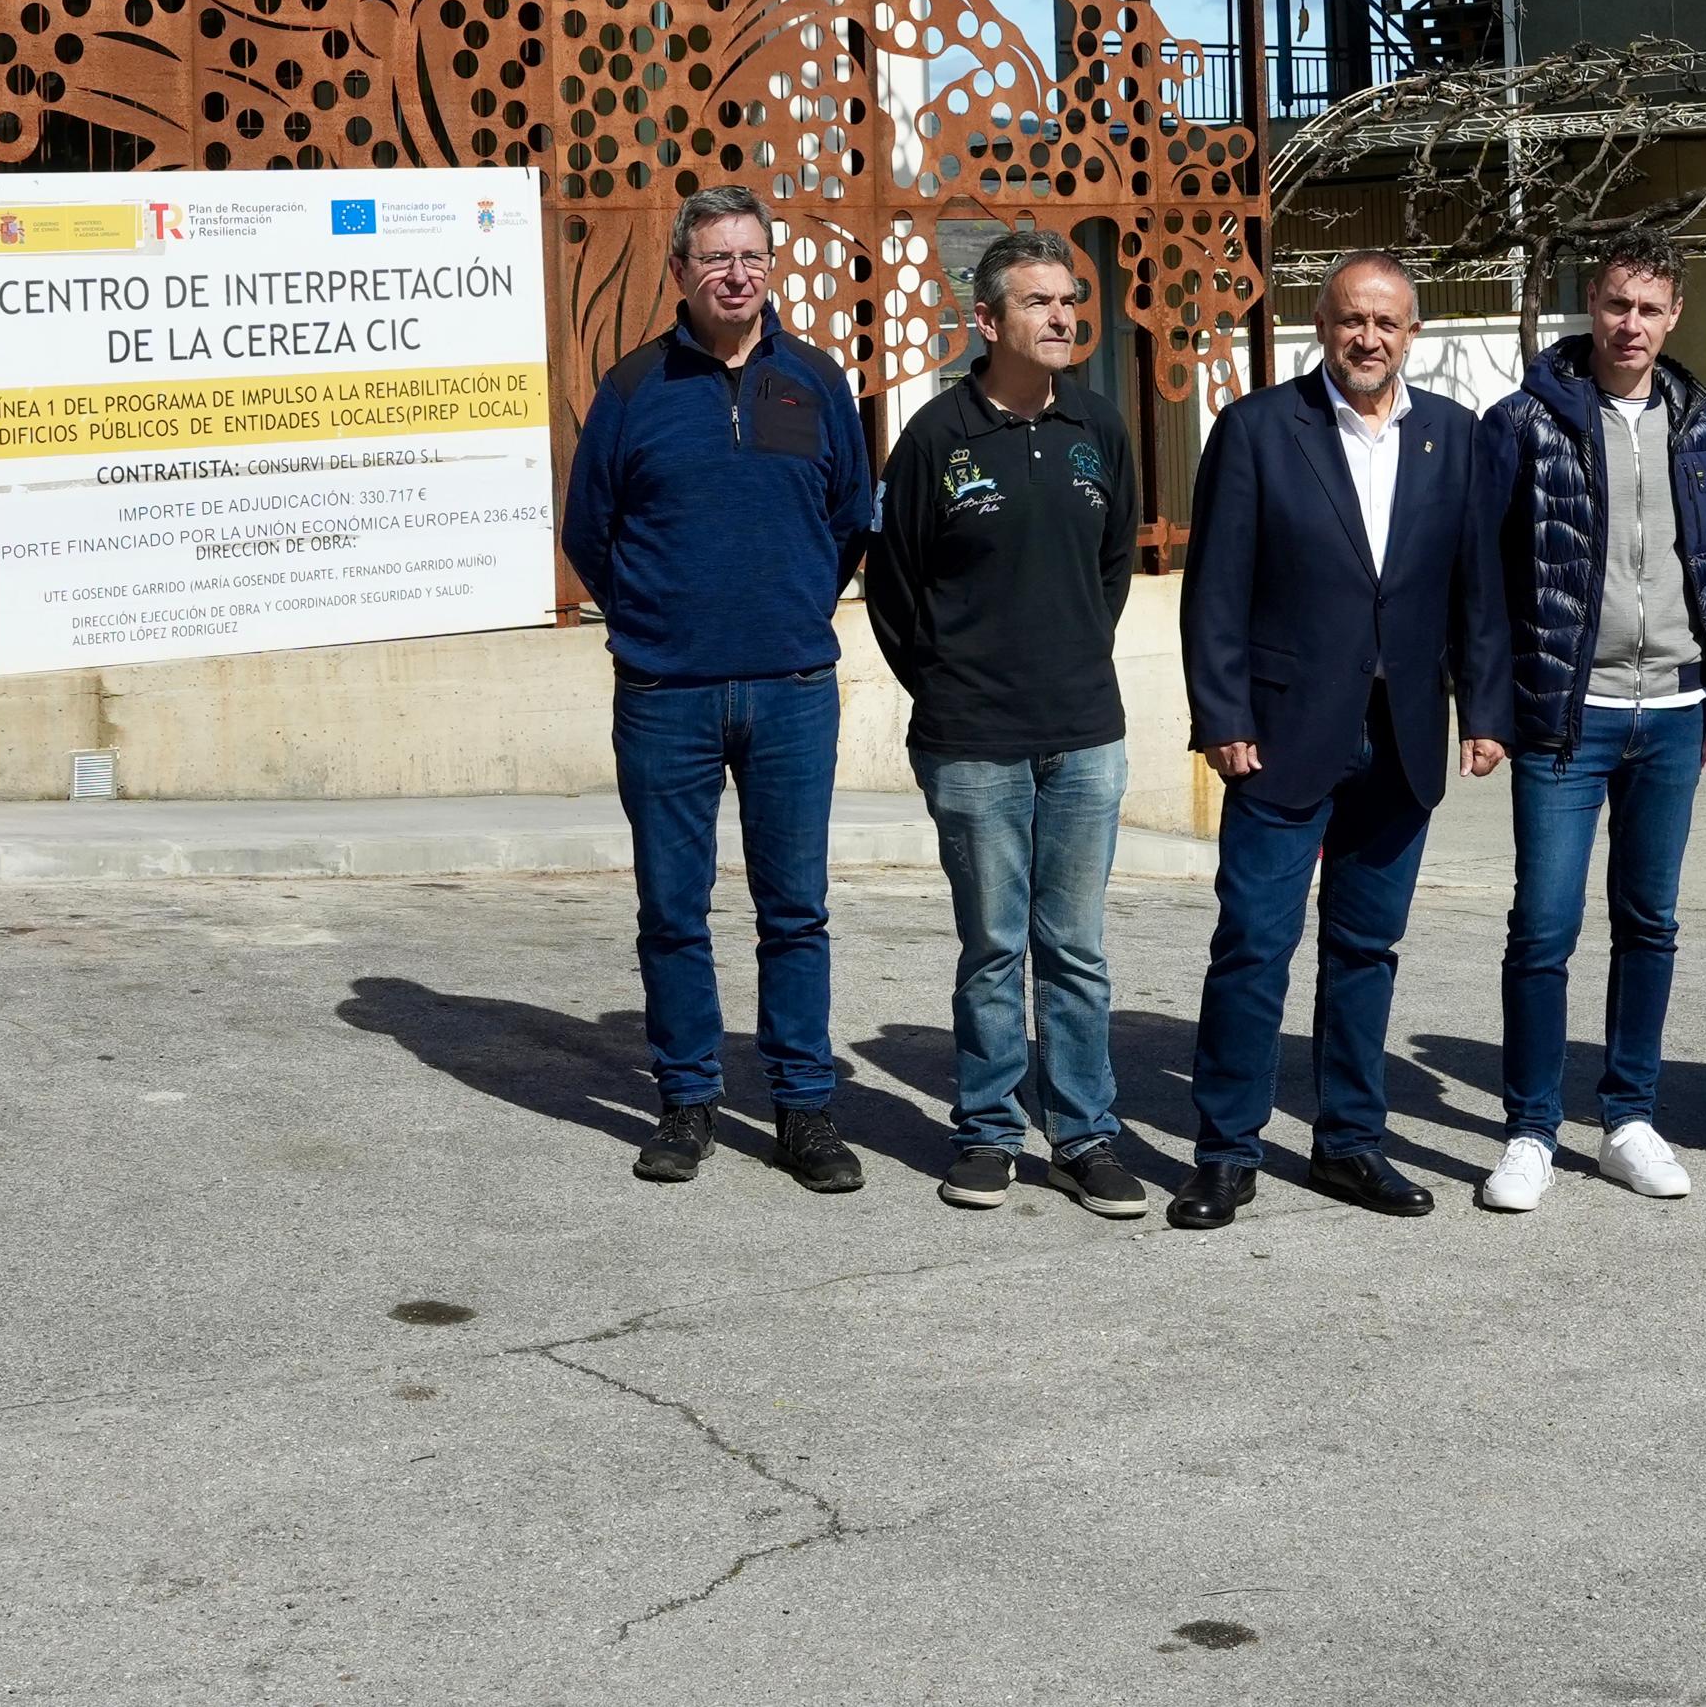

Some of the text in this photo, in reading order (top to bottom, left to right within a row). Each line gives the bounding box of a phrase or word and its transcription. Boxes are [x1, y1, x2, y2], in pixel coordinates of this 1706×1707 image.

[188, 202, 307, 215] Plan de Recuperación,
[188, 214, 273, 225] Transformación
[381, 202, 446, 212] Financiado por
[381, 213, 456, 223] la Unión Europea
[189, 226, 257, 240] y Resiliencia
[165, 274, 210, 309] DE
[225, 256, 512, 305] INTERPRETACIÓN
[108, 317, 421, 364] DE LA CEREZA CIC
[47, 399, 54, 416] 1
[64, 397, 99, 416] DEL
[105, 393, 207, 413] PROGRAMA
[212, 390, 235, 408] DE
[242, 385, 317, 406] IMPULSO
[322, 385, 334, 402] A
[339, 384, 360, 401] LA
[365, 373, 500, 399] REHABILITACIÓN
[507, 374, 527, 392] DE
[89, 418, 179, 440] PÚBLICOS
[190, 416, 213, 435] DE
[224, 411, 320, 433] ENTIDADES
[330, 403, 459, 427] LOCALES(PIREP
[469, 400, 528, 419] LOCAL)
[97, 460, 240, 485] CONTRATISTA:
[247, 449, 444, 475] CONSURVI DEL BIERZO S.L
[956, 469, 969, 485] 3
[119, 487, 427, 522] IMPORTE DE ADJUDICACIÓN: 330.717 €
[67, 531, 175, 554] FINANCIADO
[180, 525, 216, 544] POR
[221, 525, 241, 541] LA
[245, 517, 296, 539] UNIÓN
[302, 515, 401, 534] ECONÓMICA
[404, 511, 480, 528] EUROPEA
[484, 506, 537, 523] 236.452
[540, 505, 549, 520] €
[286, 537, 305, 554] DE
[310, 534, 356, 551] OBRA:
[44, 554, 497, 603] UTE GOSENDE GARRIDO (MARÍA GOSENDE DUARTE, FERNANDO GARRIDO MUIÑO)
[72, 583, 473, 629] DIRECCIÓN EJECUCIÓN DE OBRA Y COORDINADOR SEGURIDAD Y SALUD:
[72, 630, 126, 646] ALBERTO
[129, 626, 167, 642] LÓPEZ
